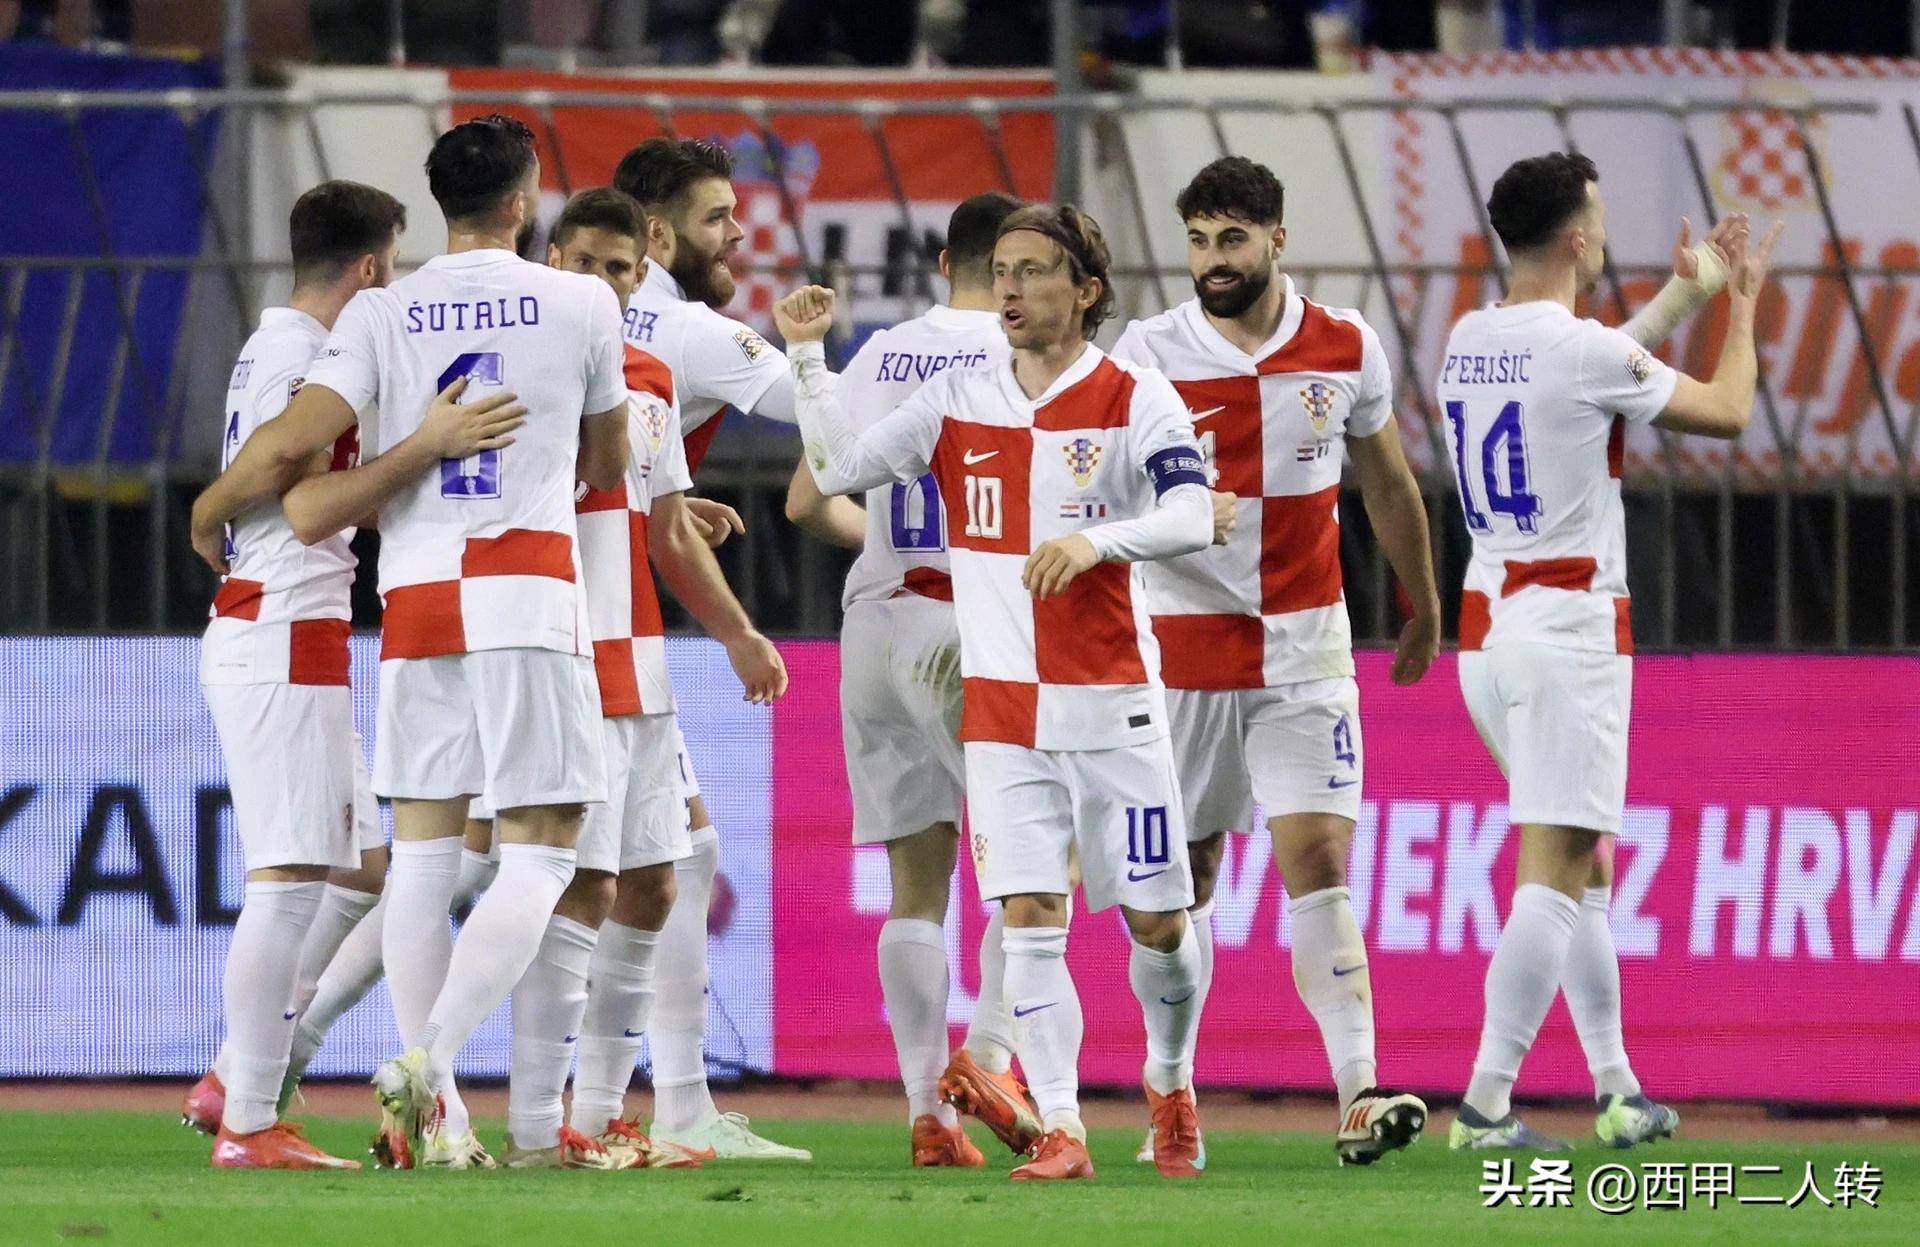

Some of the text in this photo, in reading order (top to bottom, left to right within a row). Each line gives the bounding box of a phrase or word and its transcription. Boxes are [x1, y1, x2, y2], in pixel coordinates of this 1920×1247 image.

[407, 294, 539, 334] ŠUTALO
[1442, 348, 1532, 385] PERIŠIĆ
[1445, 400, 1543, 536] 14
[964, 474, 1003, 540] 10
[1333, 713, 1356, 769] 4
[1125, 806, 1171, 865] 10
